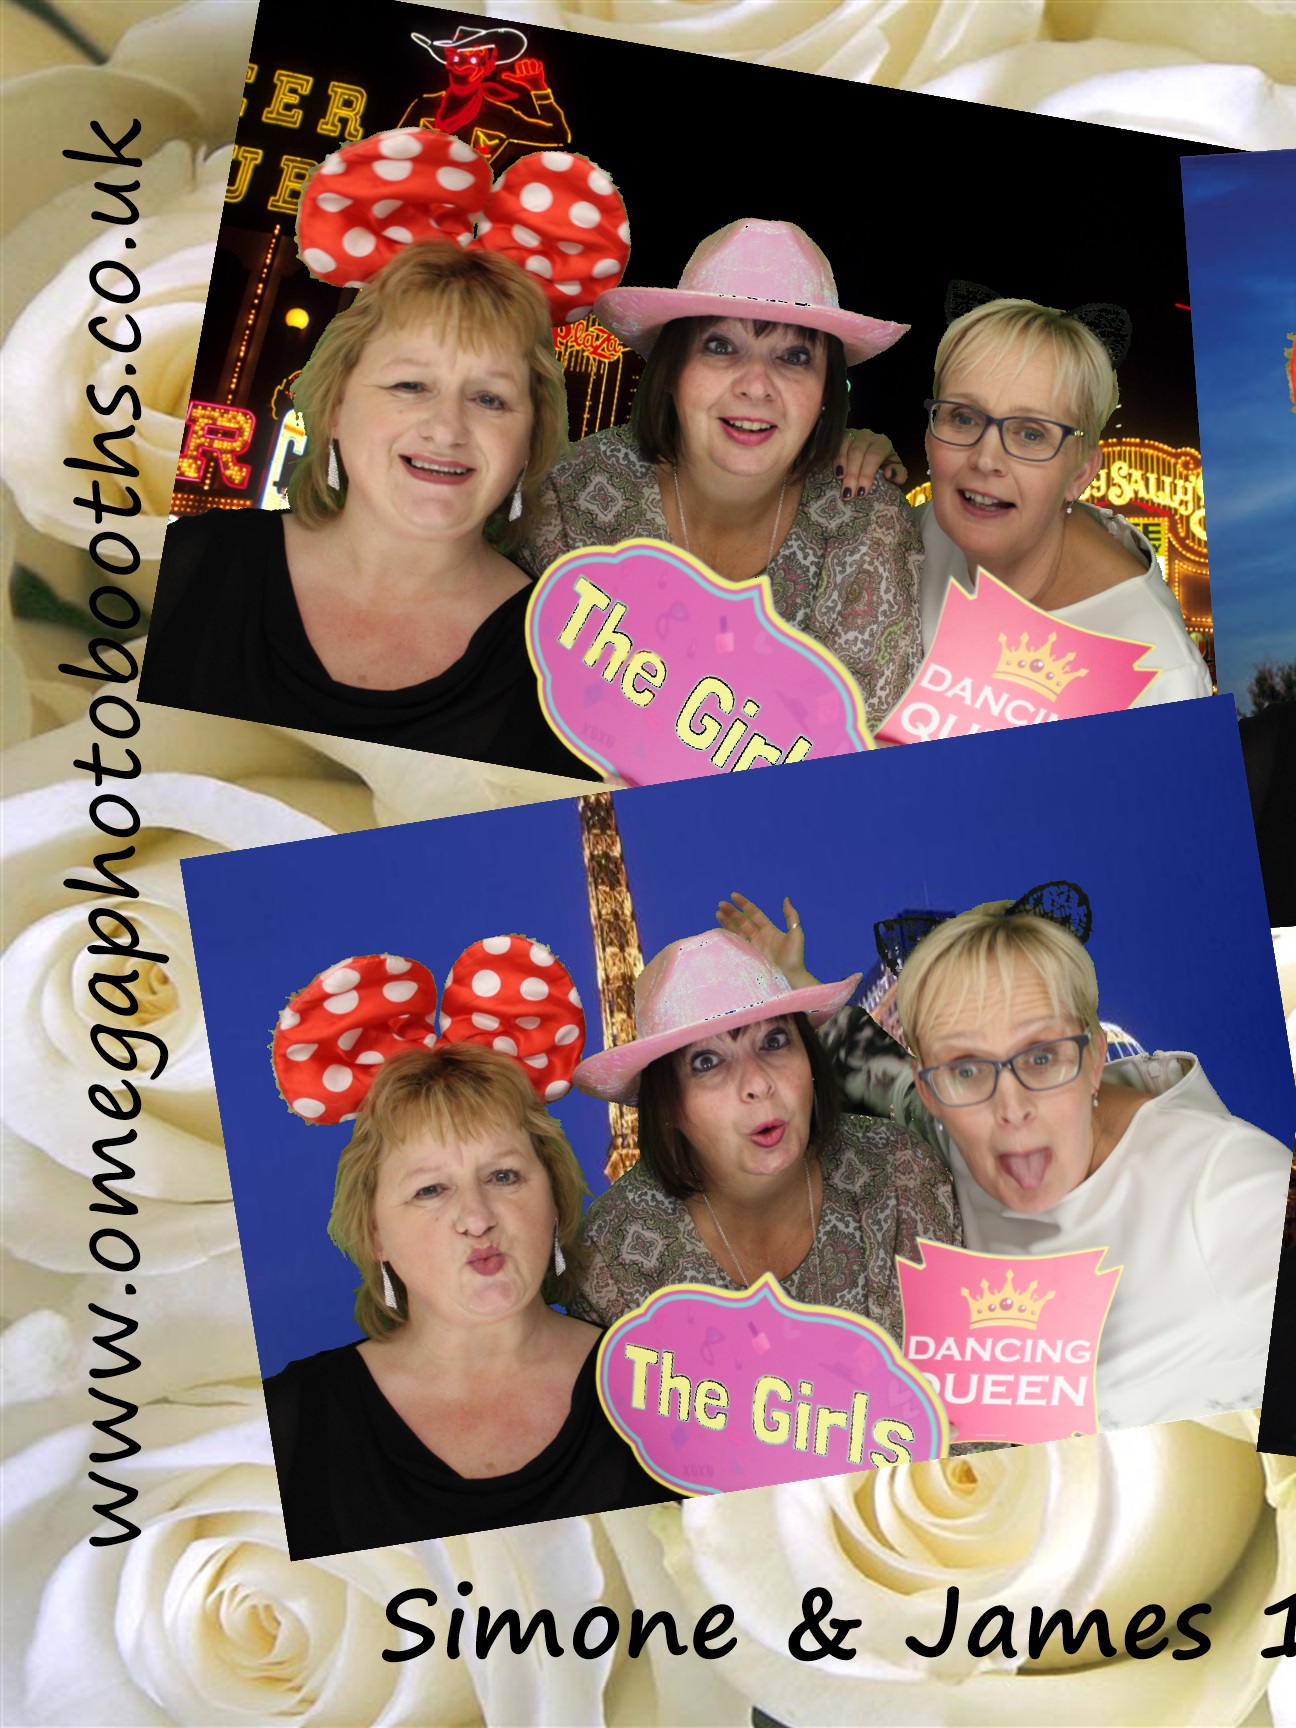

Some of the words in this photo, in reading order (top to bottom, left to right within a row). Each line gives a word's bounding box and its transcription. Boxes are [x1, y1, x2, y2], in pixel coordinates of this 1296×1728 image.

[239, 63, 367, 142] ER
[557, 575, 667, 707] The
[908, 1336, 1092, 1364] DANCING
[624, 1342, 731, 1431] The
[752, 1374, 916, 1469] Girls
